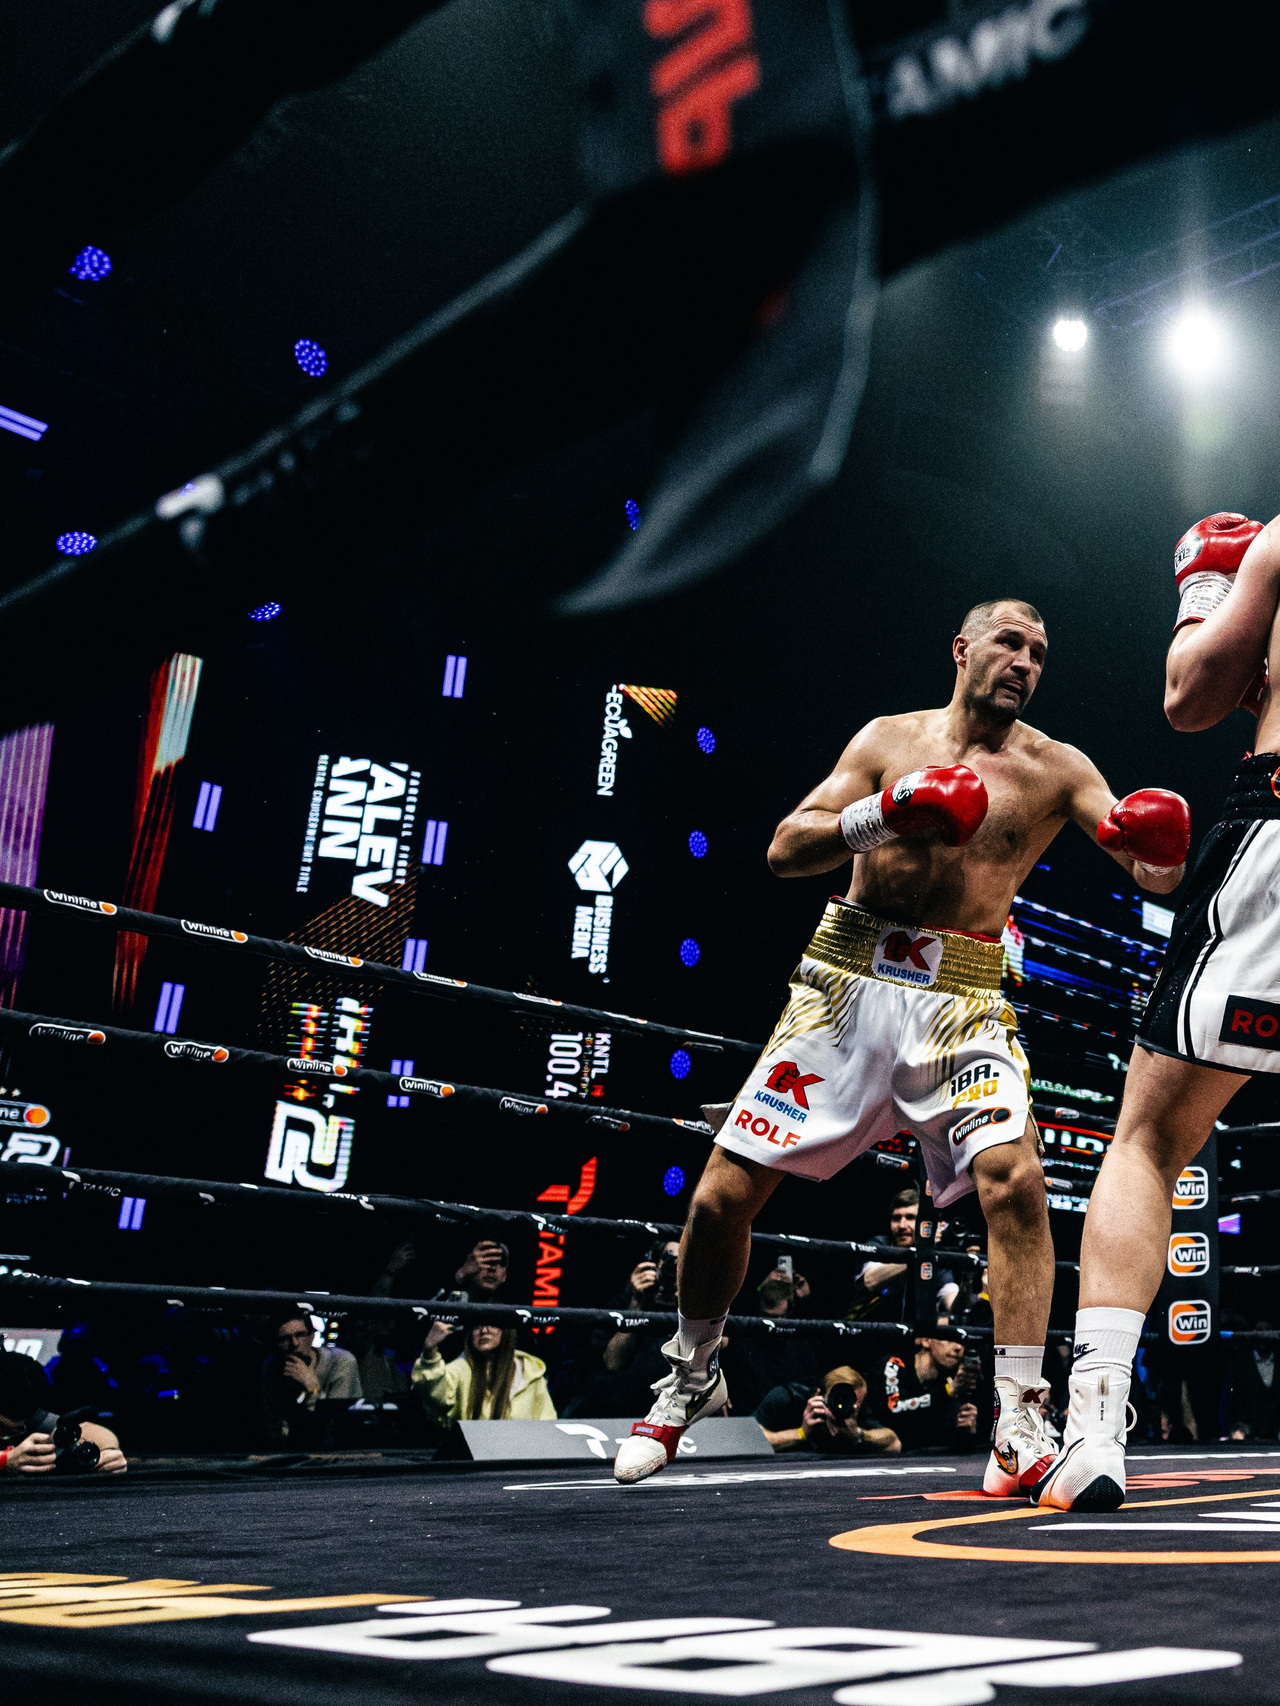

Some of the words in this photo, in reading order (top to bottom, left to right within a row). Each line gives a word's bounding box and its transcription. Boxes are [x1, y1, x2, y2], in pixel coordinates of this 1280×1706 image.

[888, 0, 1089, 119] AMIC
[401, 771, 421, 837] FAREWELL
[352, 762, 409, 908] ALEV
[51, 890, 98, 909] Winline
[187, 920, 231, 938] Winline
[571, 905, 594, 959] MEDIA
[588, 895, 613, 974] BUSINESS
[877, 963, 931, 985] KRUSHER
[293, 1060, 332, 1073] Winline
[545, 1032, 583, 1099] 100.4
[403, 1080, 439, 1094] Winline
[754, 1090, 808, 1123] KRUSHER
[734, 1109, 802, 1148] ROLF
[955, 1114, 989, 1141] Winline
[1176, 1181, 1205, 1195] Win
[1177, 1248, 1206, 1262] Win
[624, 1317, 650, 1328] TAMIC
[1178, 1317, 1208, 1331] Win
